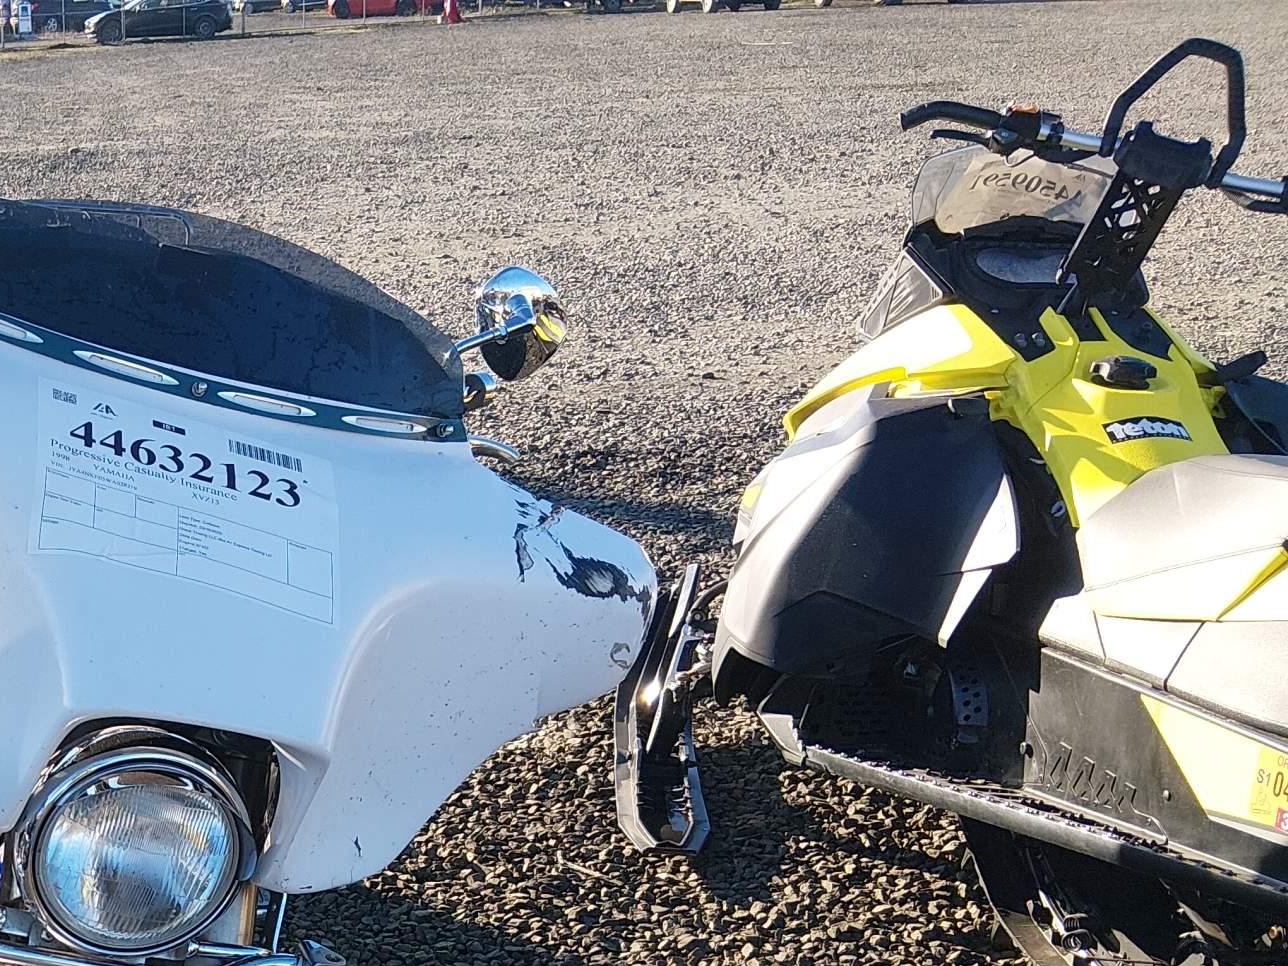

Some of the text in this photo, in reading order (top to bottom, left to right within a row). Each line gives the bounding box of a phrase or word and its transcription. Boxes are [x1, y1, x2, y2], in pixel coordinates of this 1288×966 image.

[50, 438, 238, 501] Progressive Casualty Insurance
[70, 421, 301, 508] 44632123
[93, 463, 135, 482] YAMAHA
